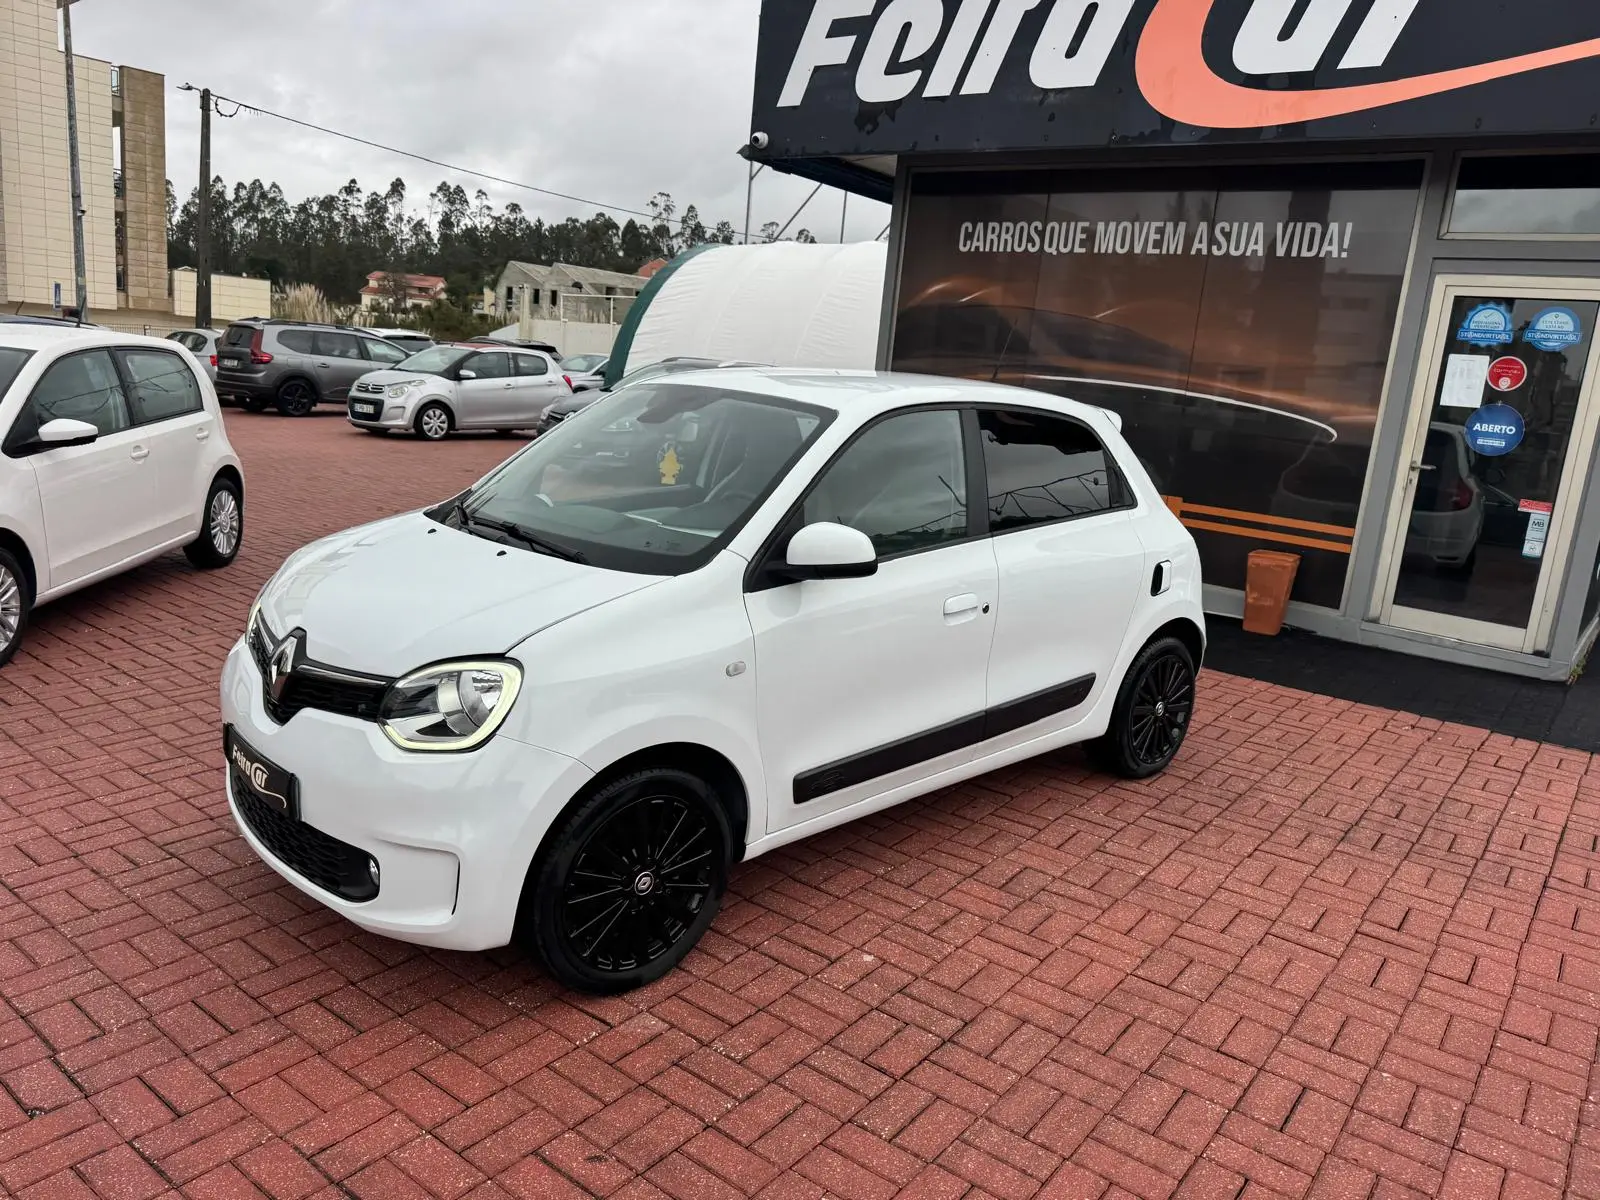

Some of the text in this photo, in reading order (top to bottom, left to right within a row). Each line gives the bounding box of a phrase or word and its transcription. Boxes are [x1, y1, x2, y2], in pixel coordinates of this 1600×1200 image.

[958, 221, 1043, 253] CARROS
[1043, 221, 1090, 255] QUE
[1093, 221, 1187, 255] MOVEM
[1275, 221, 1353, 258] VIDA!
[1473, 422, 1516, 435] ABERTO
[1531, 520, 1545, 528] MB
[232, 743, 287, 809] FeiraCar
